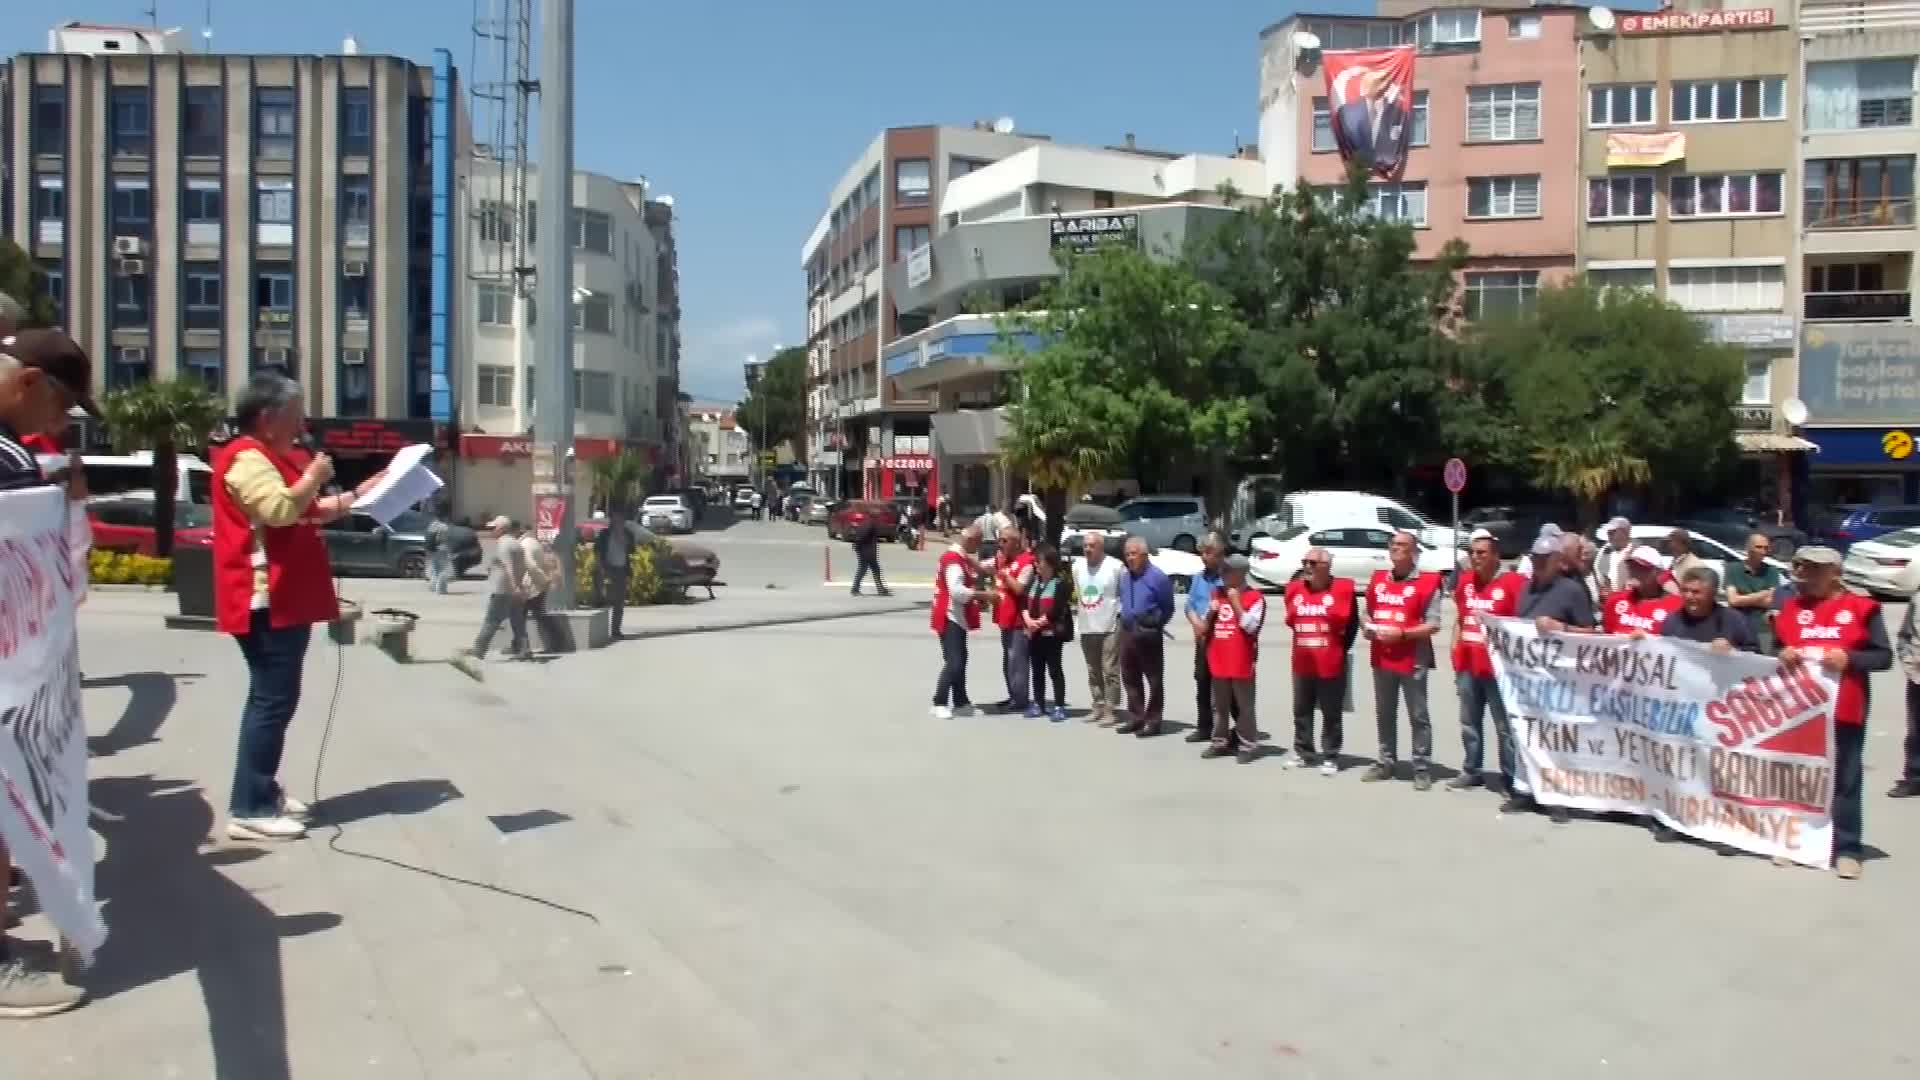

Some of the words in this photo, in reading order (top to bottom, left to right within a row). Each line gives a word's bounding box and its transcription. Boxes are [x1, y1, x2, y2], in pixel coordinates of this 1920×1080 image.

[1641, 15, 1697, 30] EMEK
[1575, 644, 1677, 690] KAMUSAL
[1508, 714, 1579, 754] TKİN
